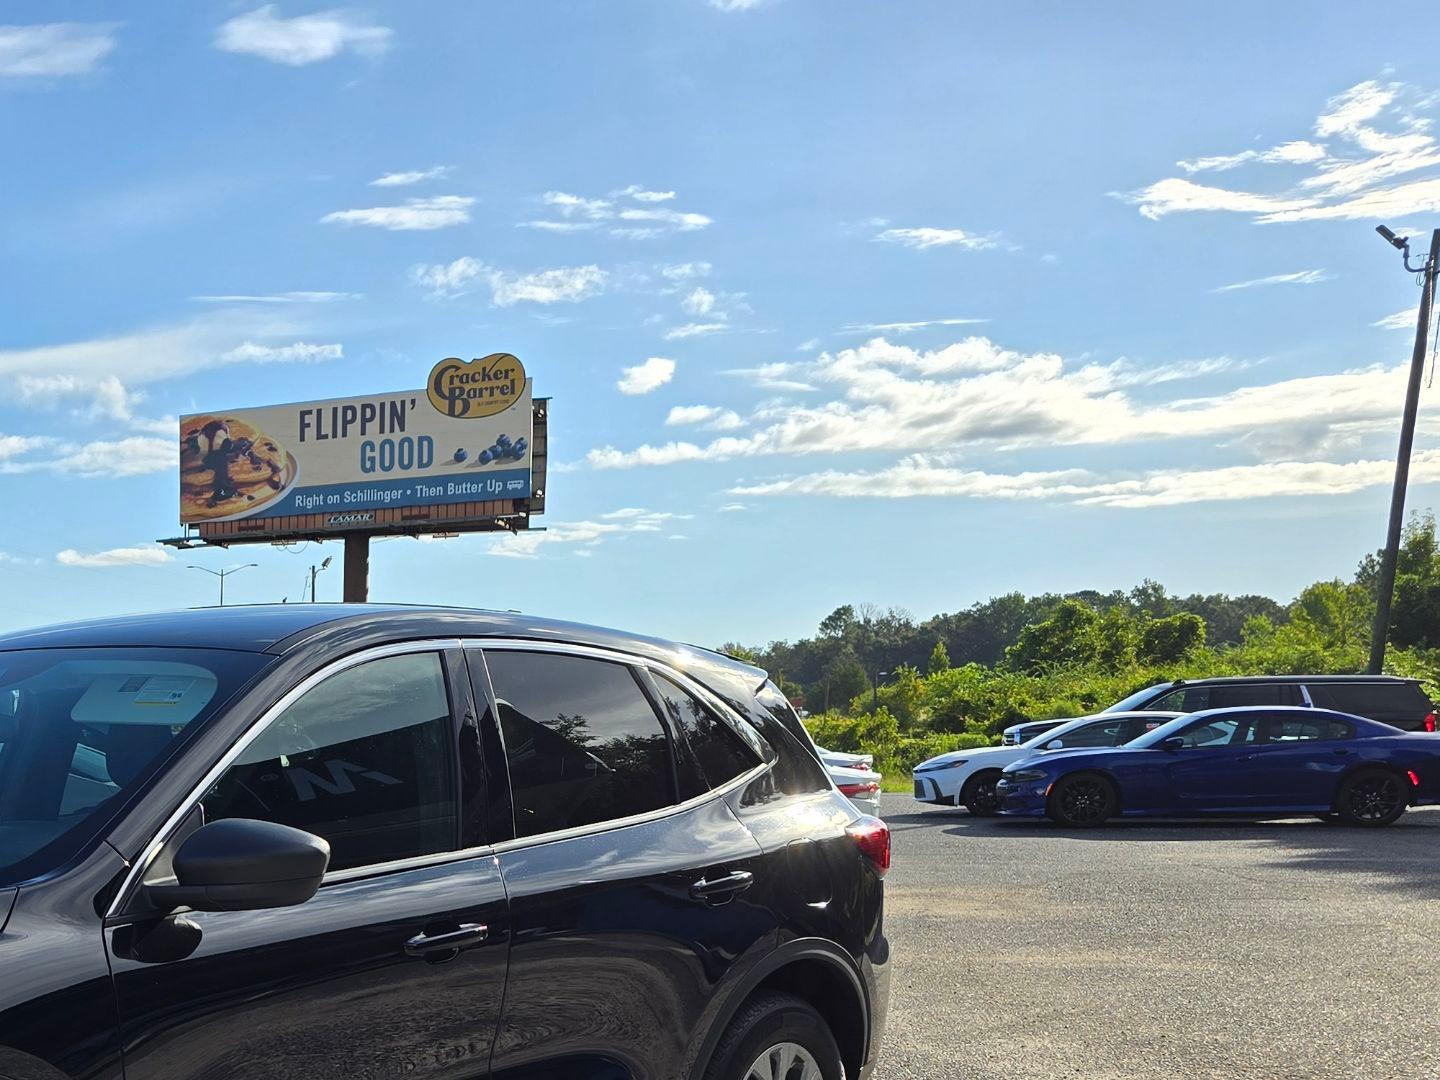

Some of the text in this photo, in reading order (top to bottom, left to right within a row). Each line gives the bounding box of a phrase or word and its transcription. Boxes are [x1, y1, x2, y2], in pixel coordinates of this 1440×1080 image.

[434, 364, 515, 400] Cracker
[447, 379, 515, 417] Barrel
[299, 398, 415, 442] FLIPPIN'
[360, 436, 434, 474] GOOD
[295, 479, 503, 509] Right on Schillinger Then Butter Up
[329, 513, 372, 524] LAMAR
